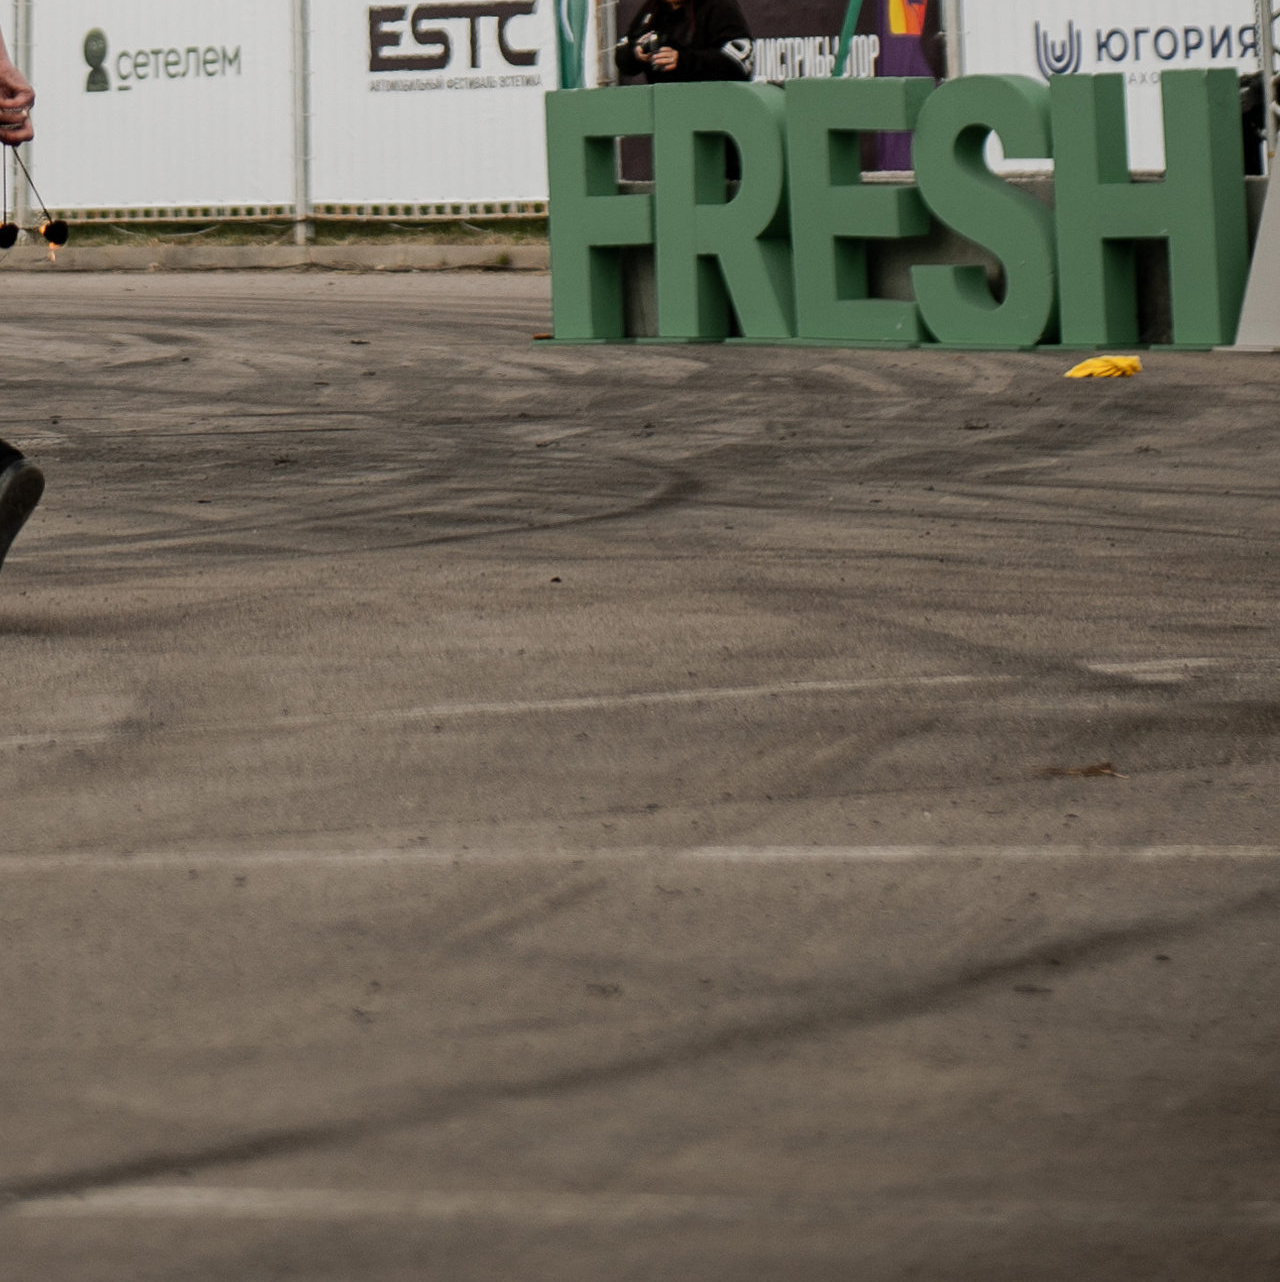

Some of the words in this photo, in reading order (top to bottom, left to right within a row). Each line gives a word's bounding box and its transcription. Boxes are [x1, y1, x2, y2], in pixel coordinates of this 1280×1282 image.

[117, 44, 242, 81] сетелем
[753, 34, 880, 82] ДИСТРИБЬТОР
[1096, 24, 1259, 62] ЮГОРИЯ
[546, 67, 1249, 349] FRESH
